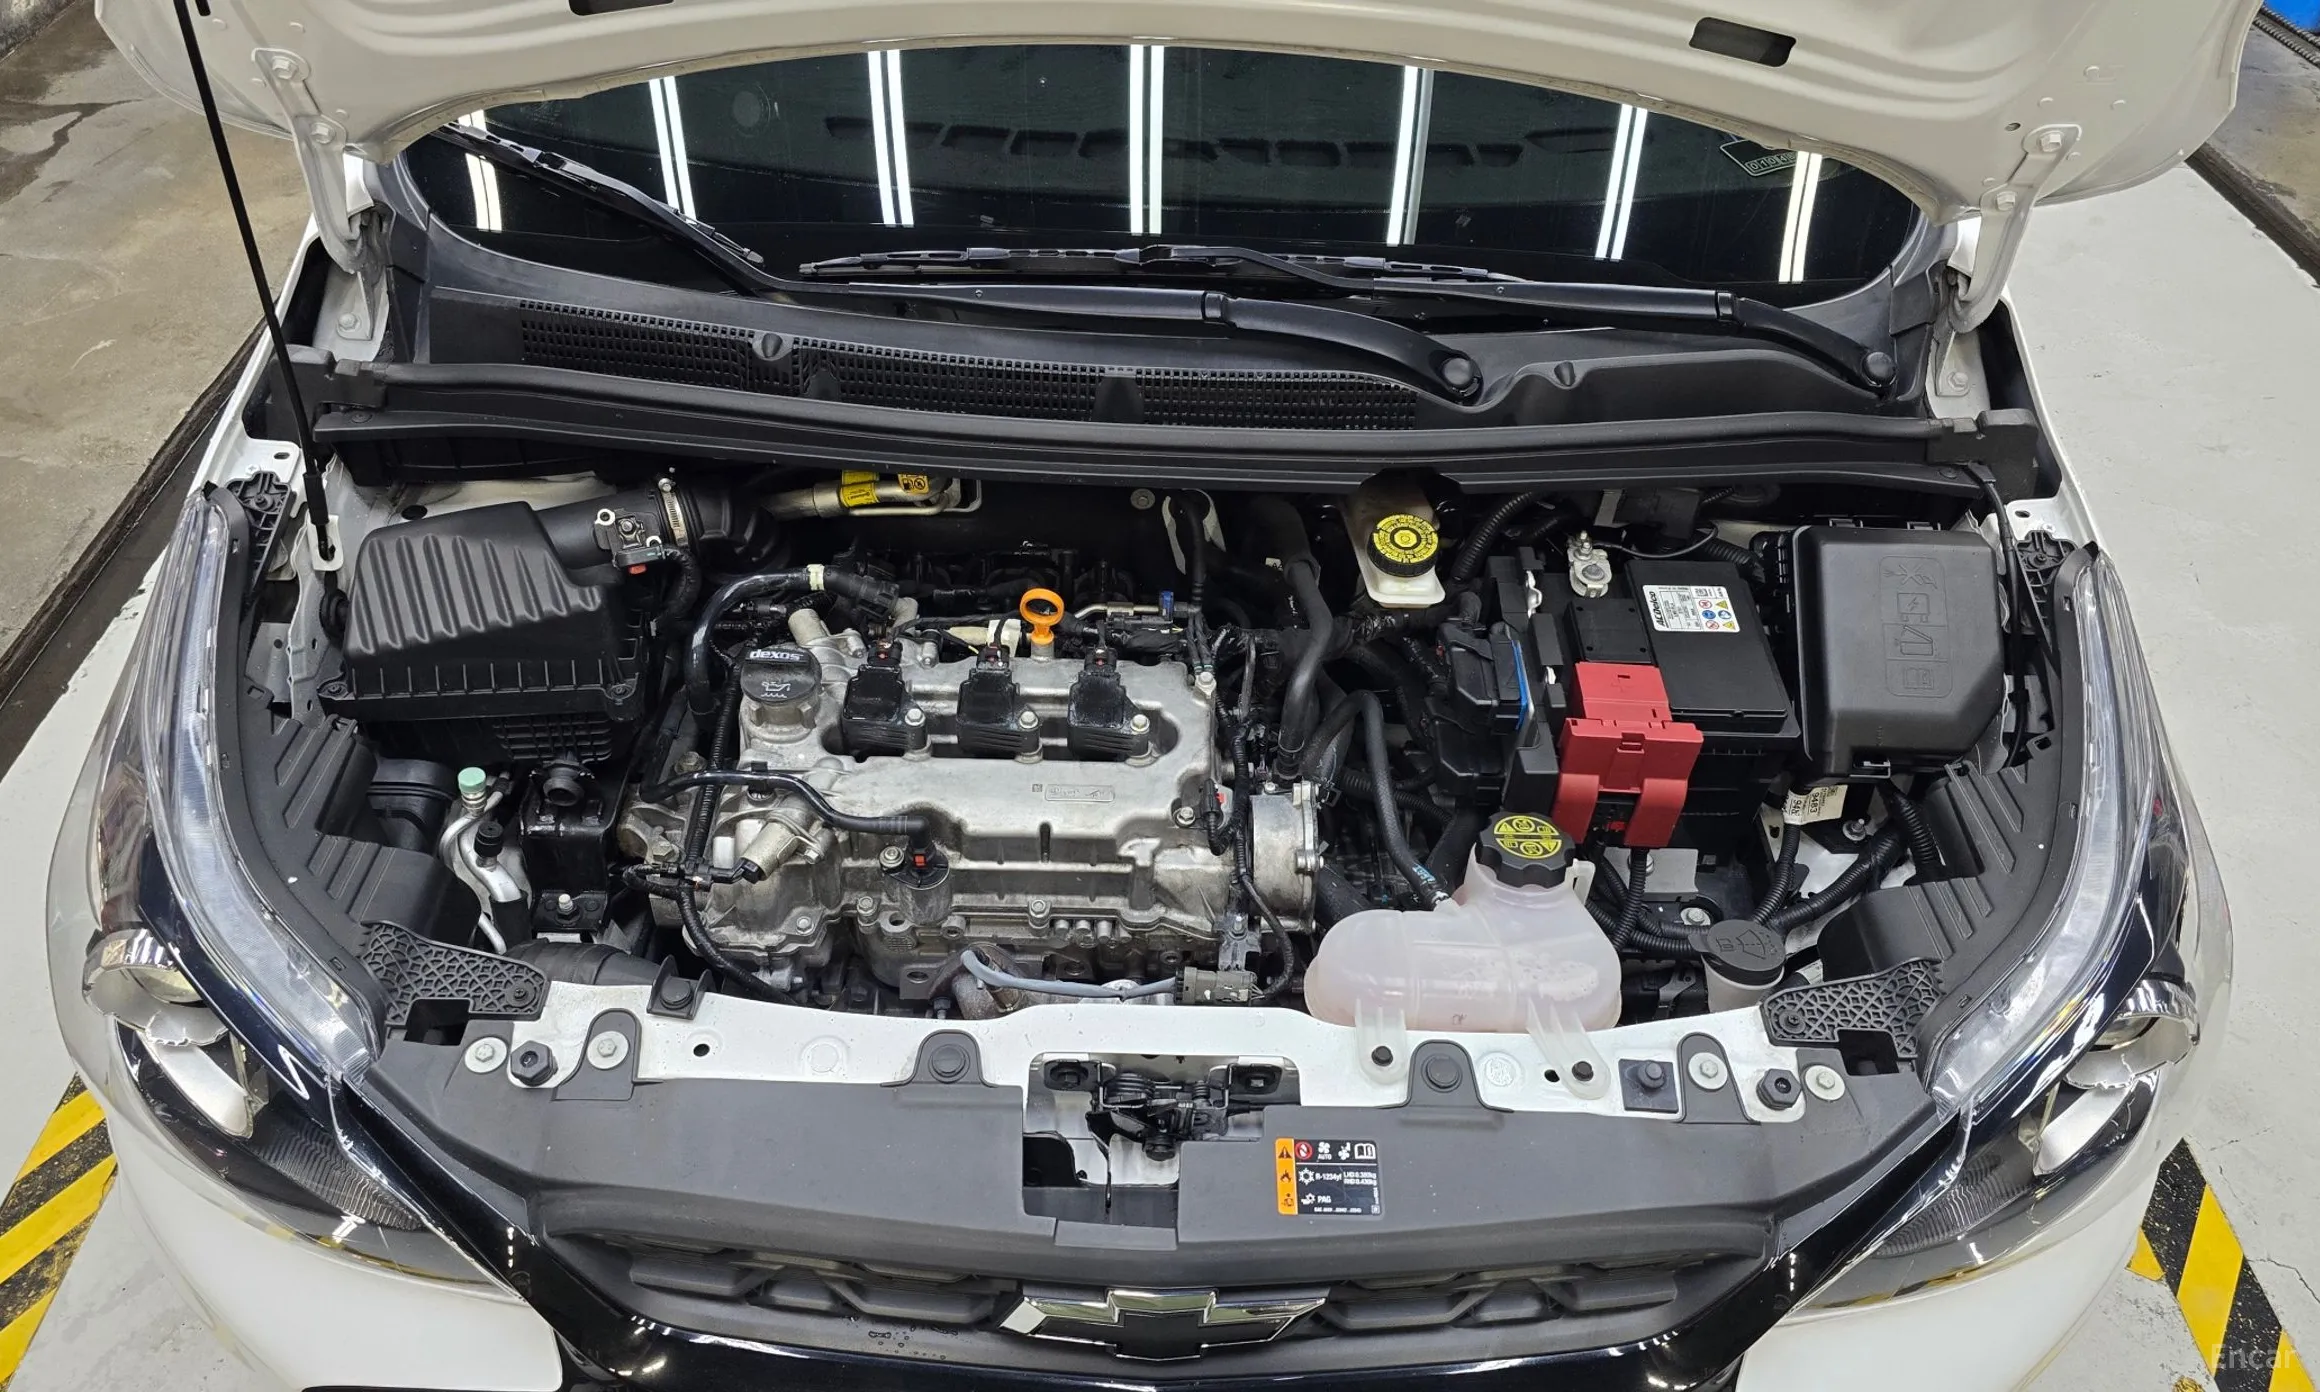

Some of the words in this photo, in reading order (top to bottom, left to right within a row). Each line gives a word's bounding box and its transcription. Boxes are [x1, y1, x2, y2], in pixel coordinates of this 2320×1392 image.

[1648, 591, 1666, 628] ACDelco
[749, 648, 804, 662] dexos
[1317, 1195, 1332, 1204] PAG
